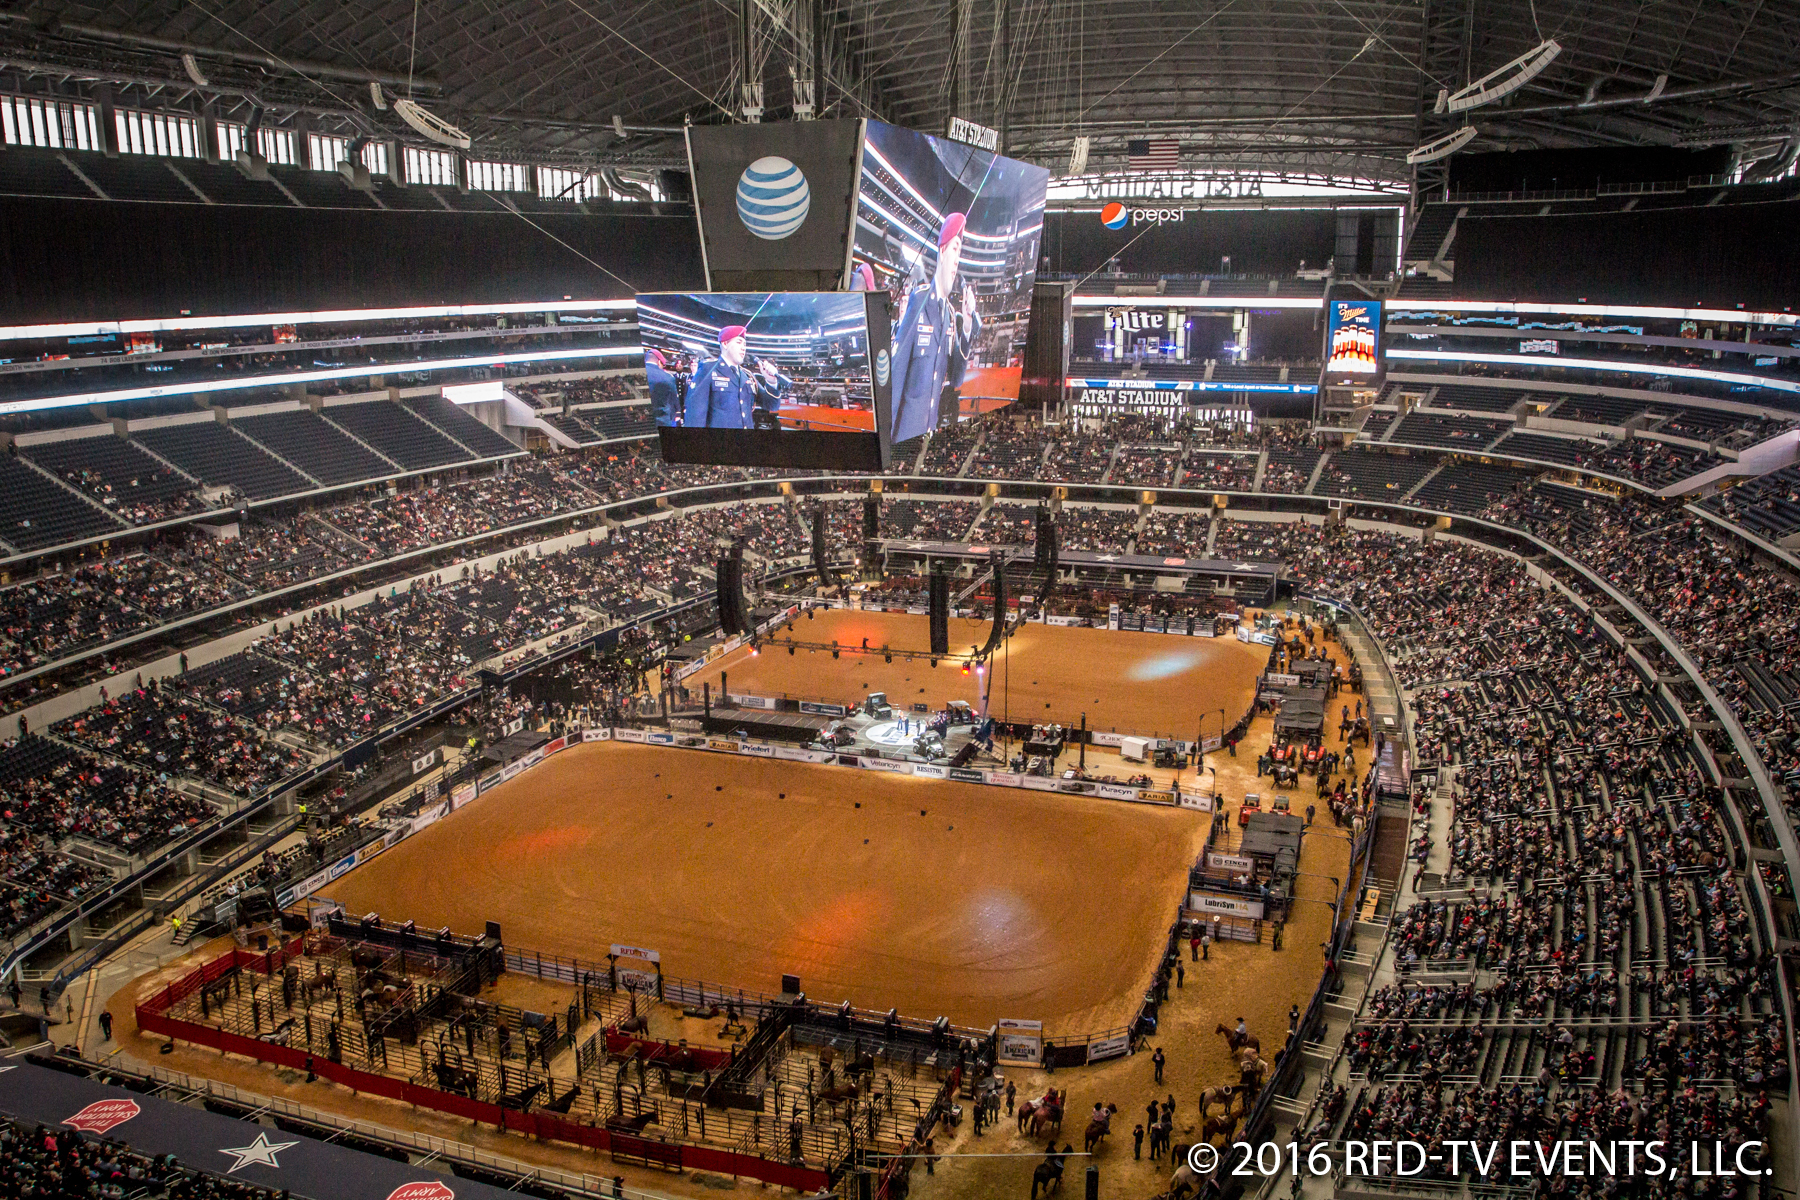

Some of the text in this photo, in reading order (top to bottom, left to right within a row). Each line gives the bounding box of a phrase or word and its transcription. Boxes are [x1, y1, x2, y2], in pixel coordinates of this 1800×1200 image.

[949, 116, 999, 151] AT&T STADIUM
[1132, 206, 1184, 226] pepsi
[1339, 307, 1367, 321] Miller
[1119, 311, 1164, 332] Lite
[1125, 380, 1156, 389] STADIUM
[1080, 389, 1183, 406] AT&T STADIUM
[742, 744, 770, 753] Priefert
[916, 765, 943, 774] RESISTOL
[1101, 786, 1132, 796] Puracyn
[397, 1186, 442, 1198] ARMY
